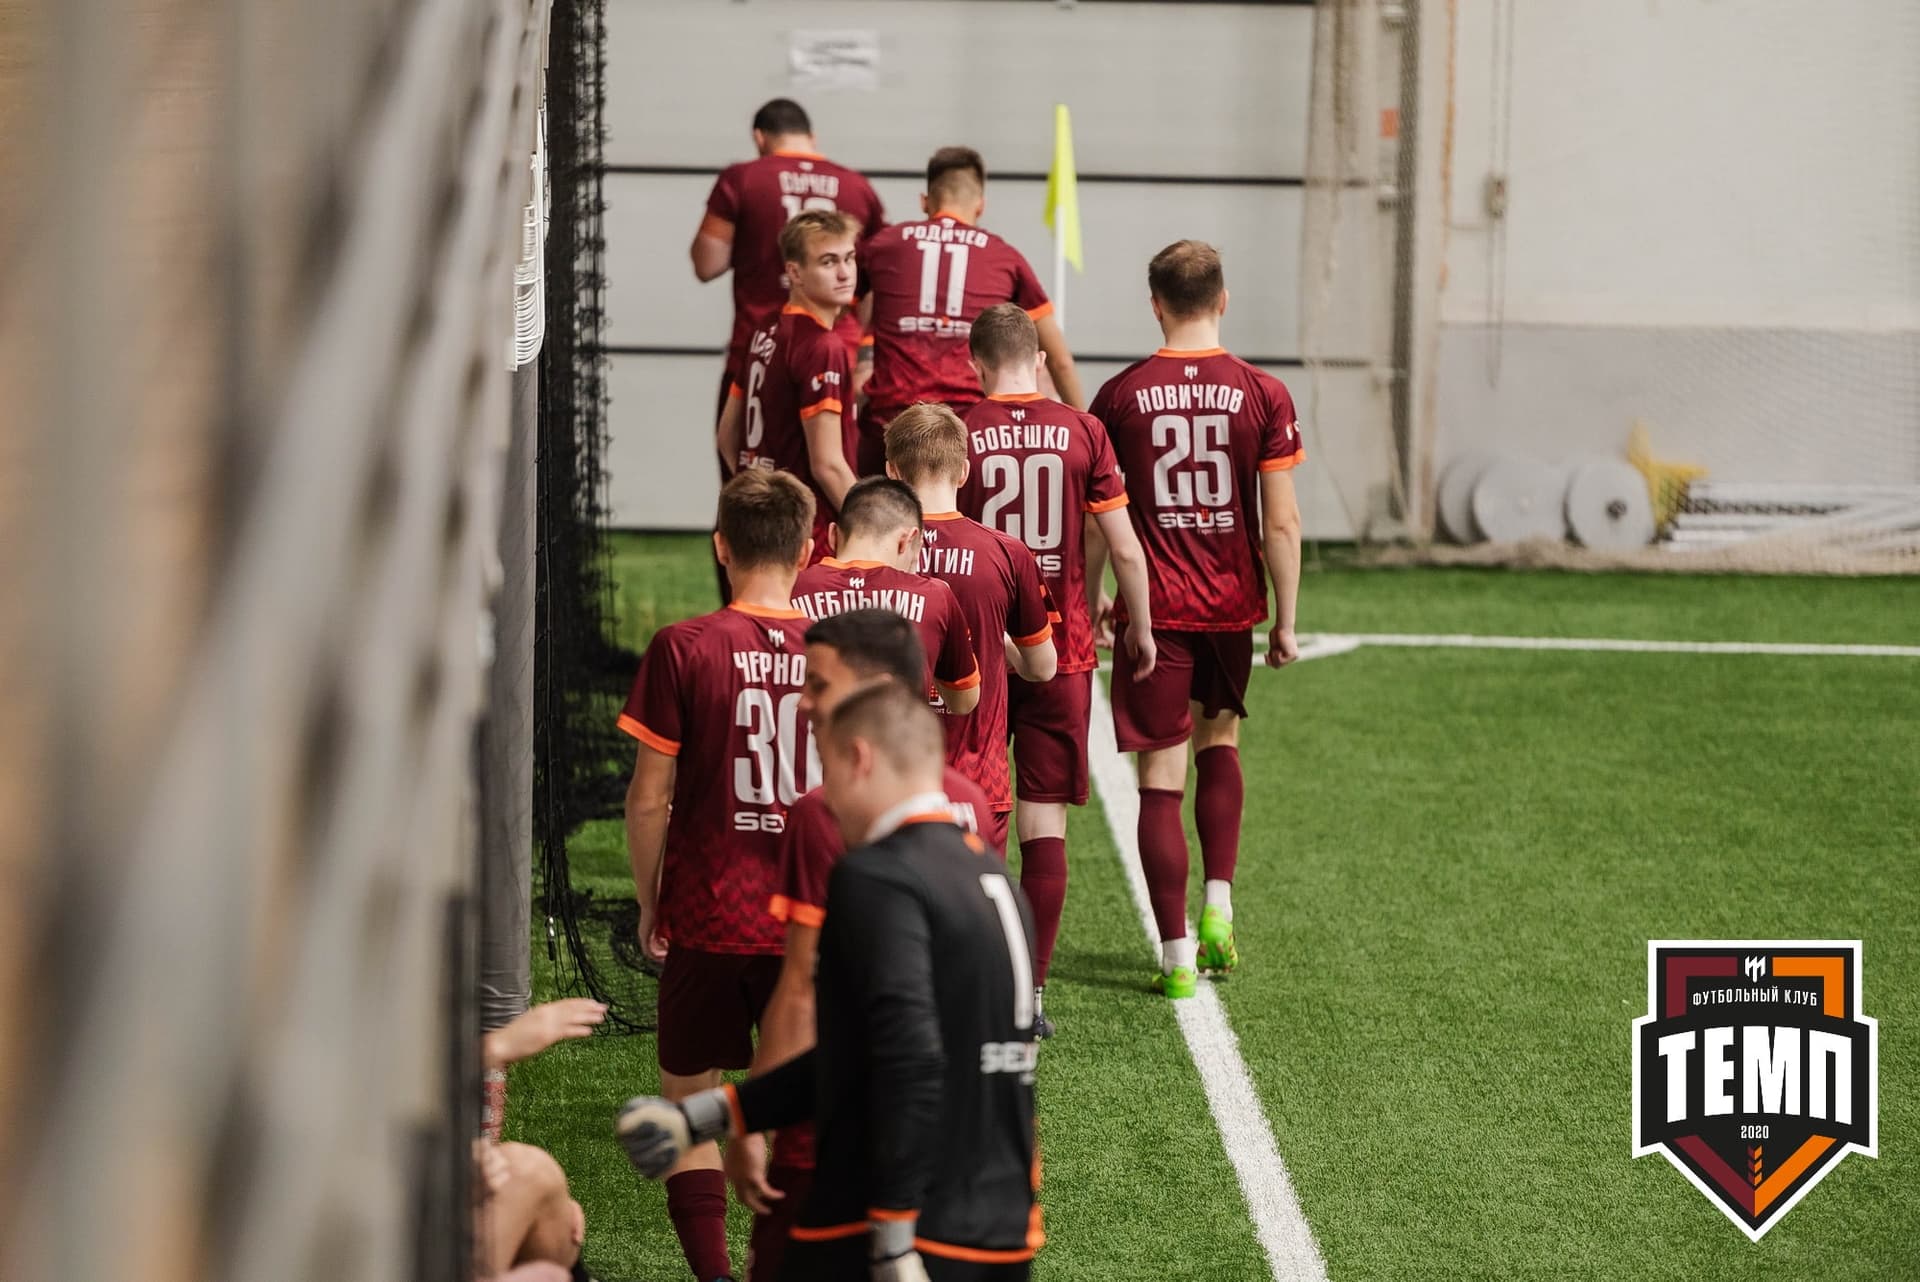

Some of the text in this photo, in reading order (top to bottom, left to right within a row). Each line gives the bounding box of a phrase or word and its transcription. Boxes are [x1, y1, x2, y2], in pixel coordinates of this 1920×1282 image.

[902, 225, 989, 248] РОДИЧЕВ
[917, 240, 969, 317] 11
[746, 361, 766, 448] 6
[1136, 384, 1244, 414] НОВИЧКОВ
[971, 425, 1069, 454] БОБЕШКО
[1152, 415, 1232, 507] 25
[982, 453, 1064, 550] 20
[1157, 511, 1234, 528] SEUS
[733, 651, 807, 687] ЧЕРНО
[734, 688, 824, 806] 30
[734, 811, 785, 833] SE
[980, 874, 1033, 1029] 1
